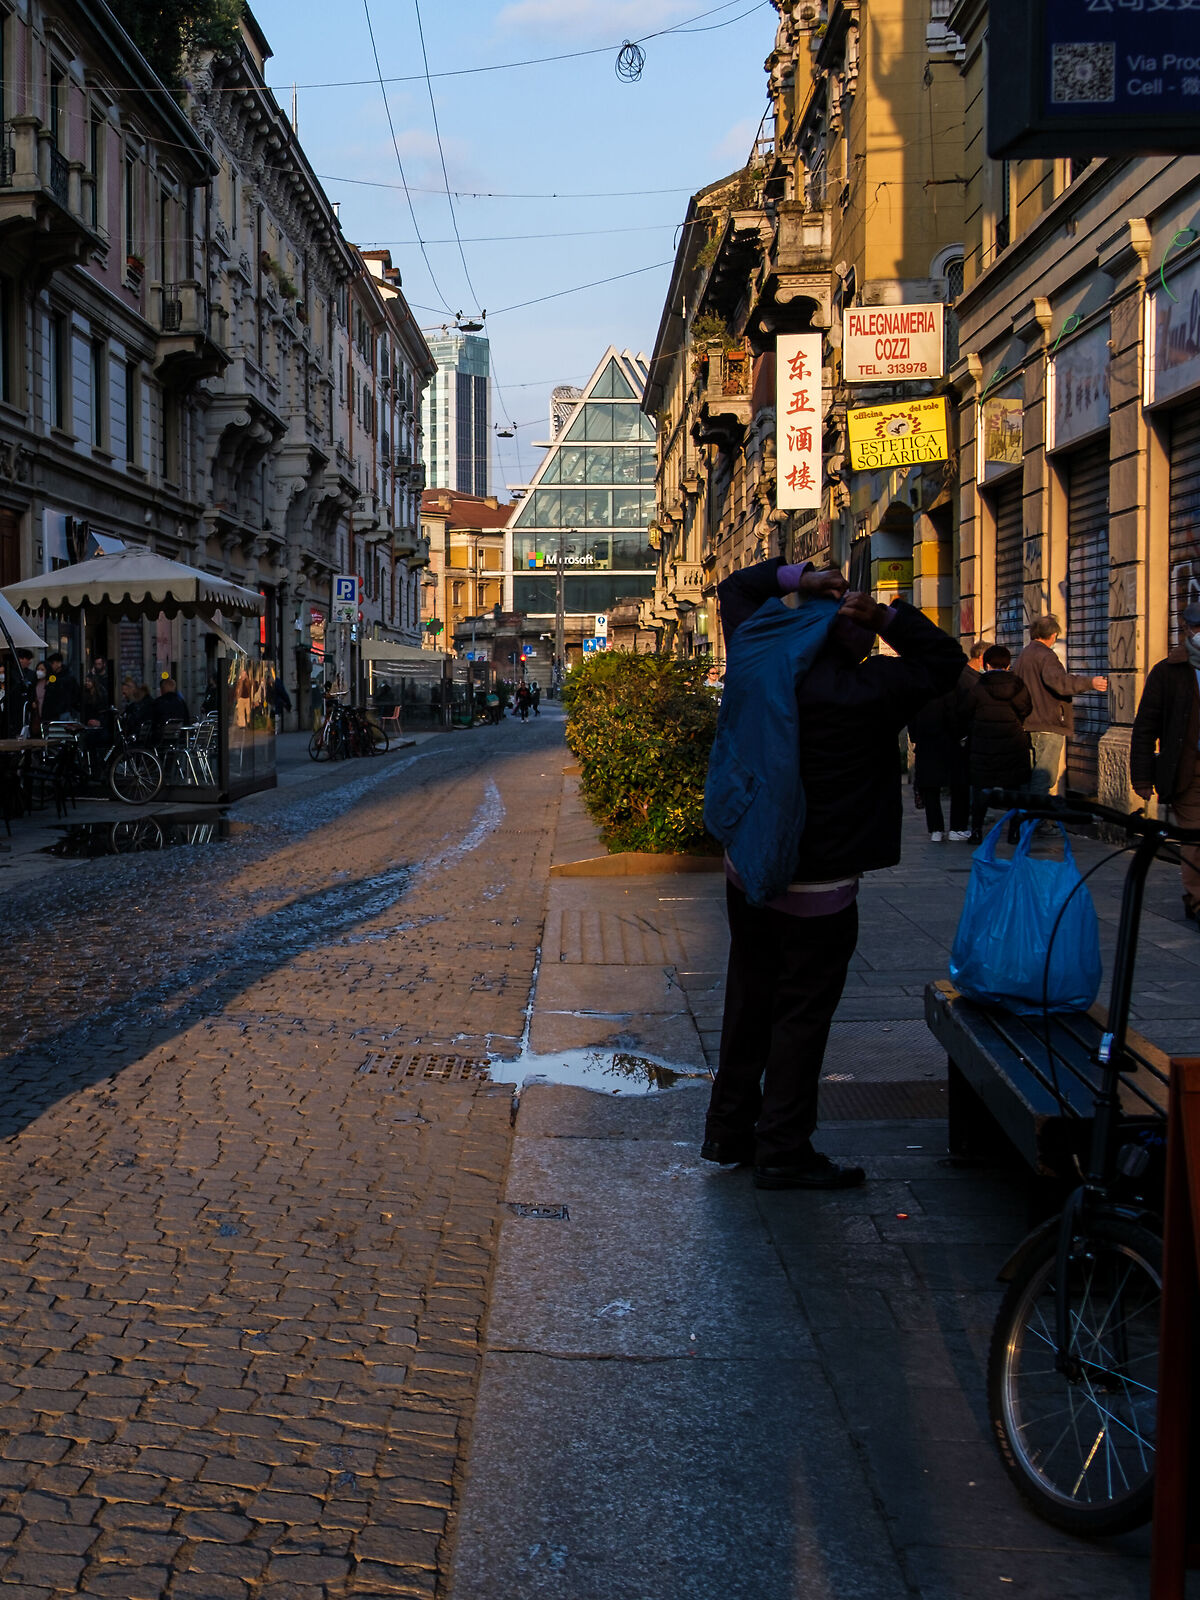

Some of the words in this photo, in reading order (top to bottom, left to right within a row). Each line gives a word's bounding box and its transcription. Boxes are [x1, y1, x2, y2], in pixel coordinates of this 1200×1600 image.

[1127, 54, 1157, 71] Via
[1126, 78, 1163, 95] Cell
[849, 311, 936, 336] FALEGNAMERIA
[875, 338, 910, 360] COZZI
[858, 364, 882, 375] TEL.
[887, 362, 928, 374] 313978
[853, 410, 884, 420] officina
[908, 404, 921, 412] del
[923, 402, 939, 411] sole
[784, 350, 816, 492] 东亚酒楼
[861, 434, 938, 455] ESTETICA
[857, 446, 942, 469] SOLARIUM
[545, 553, 594, 564] Mrosoft
